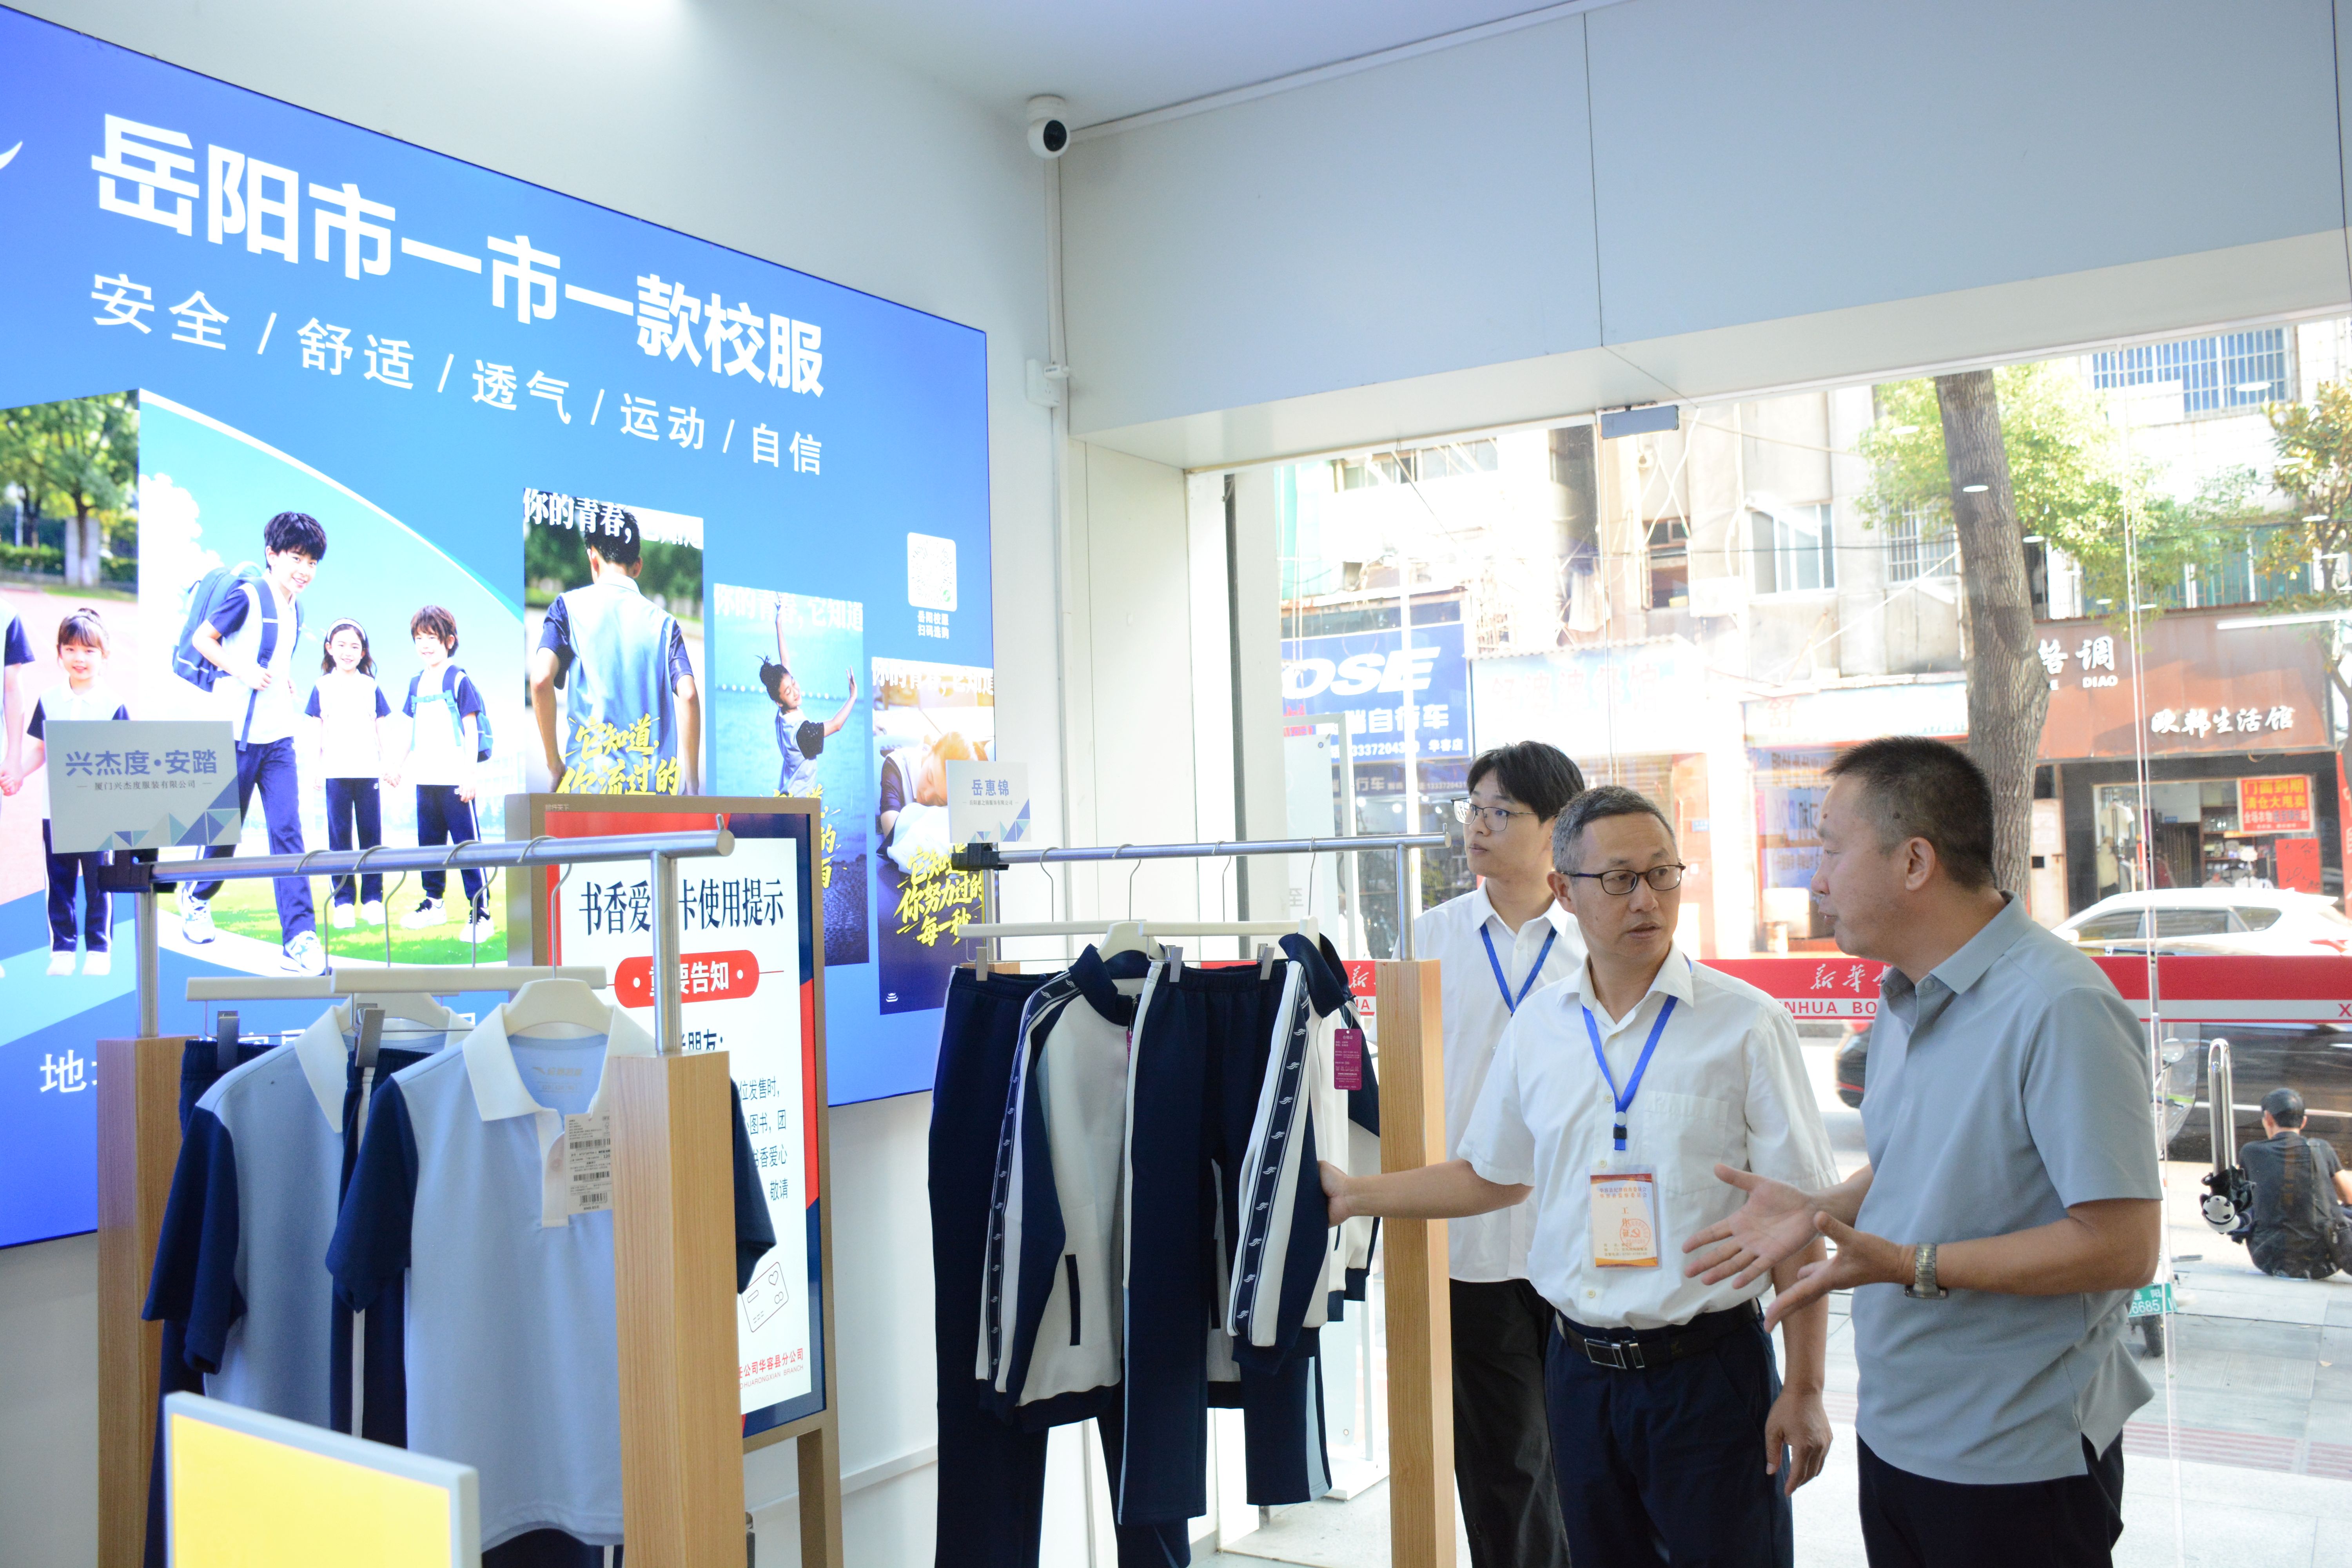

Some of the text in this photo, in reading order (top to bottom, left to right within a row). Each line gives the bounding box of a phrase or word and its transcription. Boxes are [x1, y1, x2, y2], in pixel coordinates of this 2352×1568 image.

[91, 113, 824, 398] 岳阳市一市一款校服
[91, 273, 230, 351] 安全
[297, 317, 414, 390] 舒适
[472, 358, 572, 425] 透气
[620, 393, 705, 450] 运动
[752, 423, 822, 476] 自信
[2082, 675, 2118, 688] DIAO
[2151, 705, 2296, 739] 欧韩生活馆
[575, 713, 660, 761] 它知道，
[65, 749, 218, 777] 兴杰度·安踏
[94, 780, 196, 791] 厦门兴杰度服装有限公司
[971, 779, 1009, 797] 岳惠锦
[2244, 778, 2305, 795] 门面到期
[579, 878, 785, 936] 书香爱卡使用提示
[649, 960, 730, 997] 要告知
[1779, 1001, 1838, 1014] NHUA
[40, 1049, 98, 1094] 地
[746, 1109, 787, 1136] 图书，团
[769, 1177, 788, 1201] 敬请
[2130, 1300, 2160, 1314] 6685
